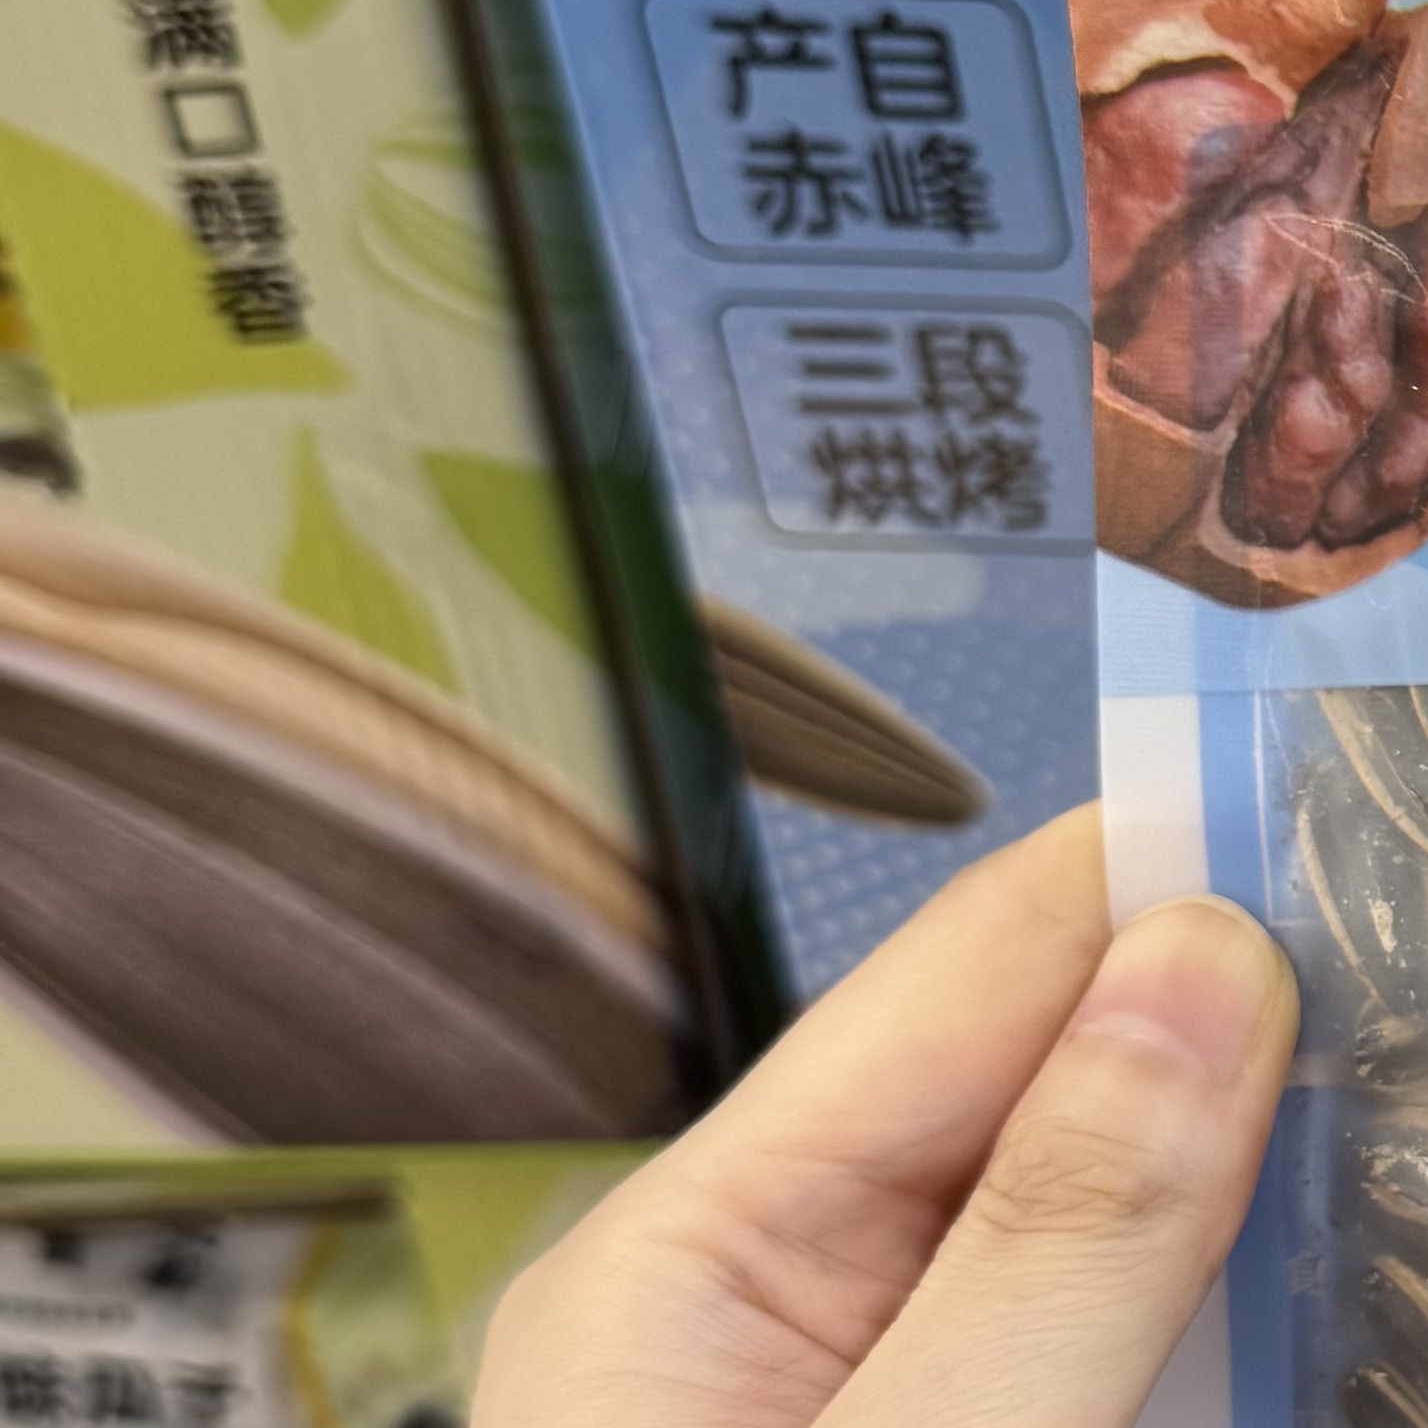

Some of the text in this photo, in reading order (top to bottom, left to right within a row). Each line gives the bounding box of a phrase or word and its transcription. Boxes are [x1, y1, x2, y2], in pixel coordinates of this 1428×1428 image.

[707, 8, 967, 122] 产自
[738, 130, 1002, 244] 赤峰
[785, 320, 1042, 427] 三段
